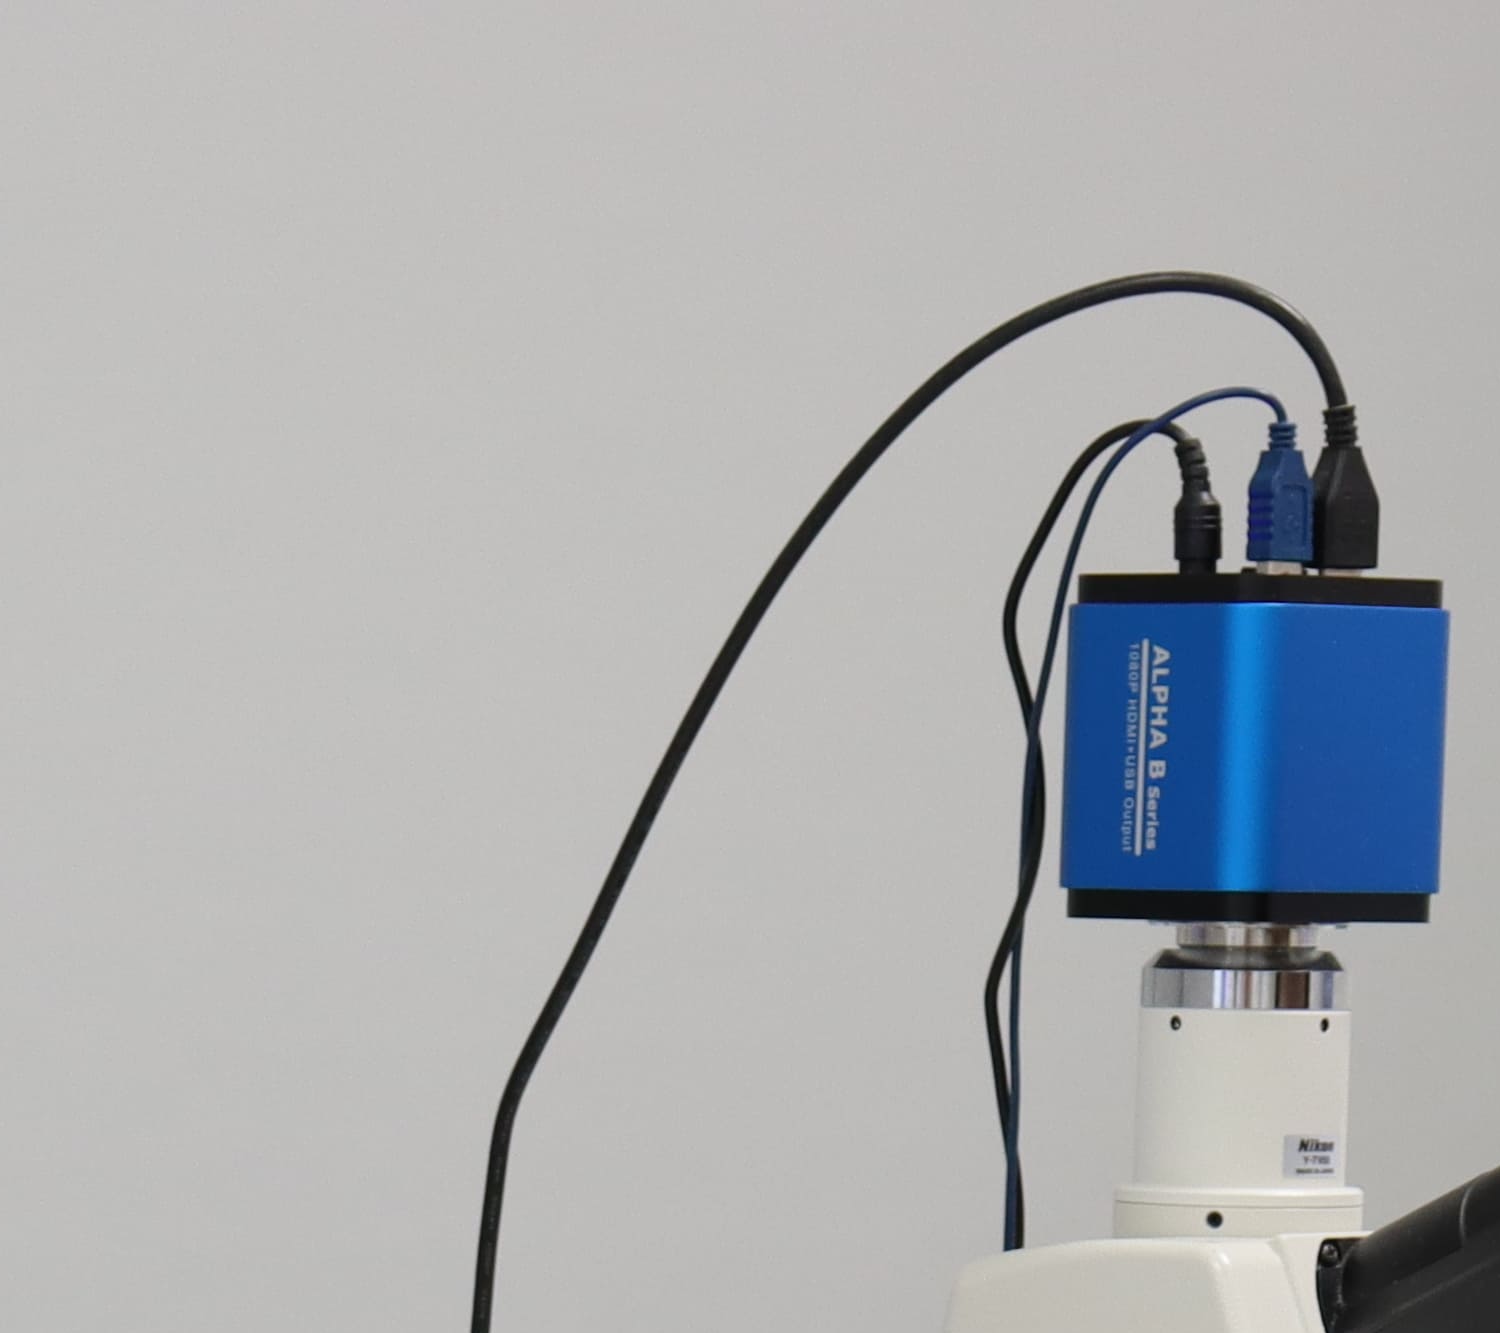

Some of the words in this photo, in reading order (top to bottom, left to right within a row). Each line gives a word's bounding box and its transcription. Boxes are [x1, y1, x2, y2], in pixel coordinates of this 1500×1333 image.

[1128, 643, 1140, 693] 1080P
[1148, 644, 1171, 749] ALPHA
[1148, 759, 1167, 779] B
[1121, 796, 1135, 852] Output
[1146, 785, 1161, 850] Series
[1298, 1138, 1335, 1153] Nikon
